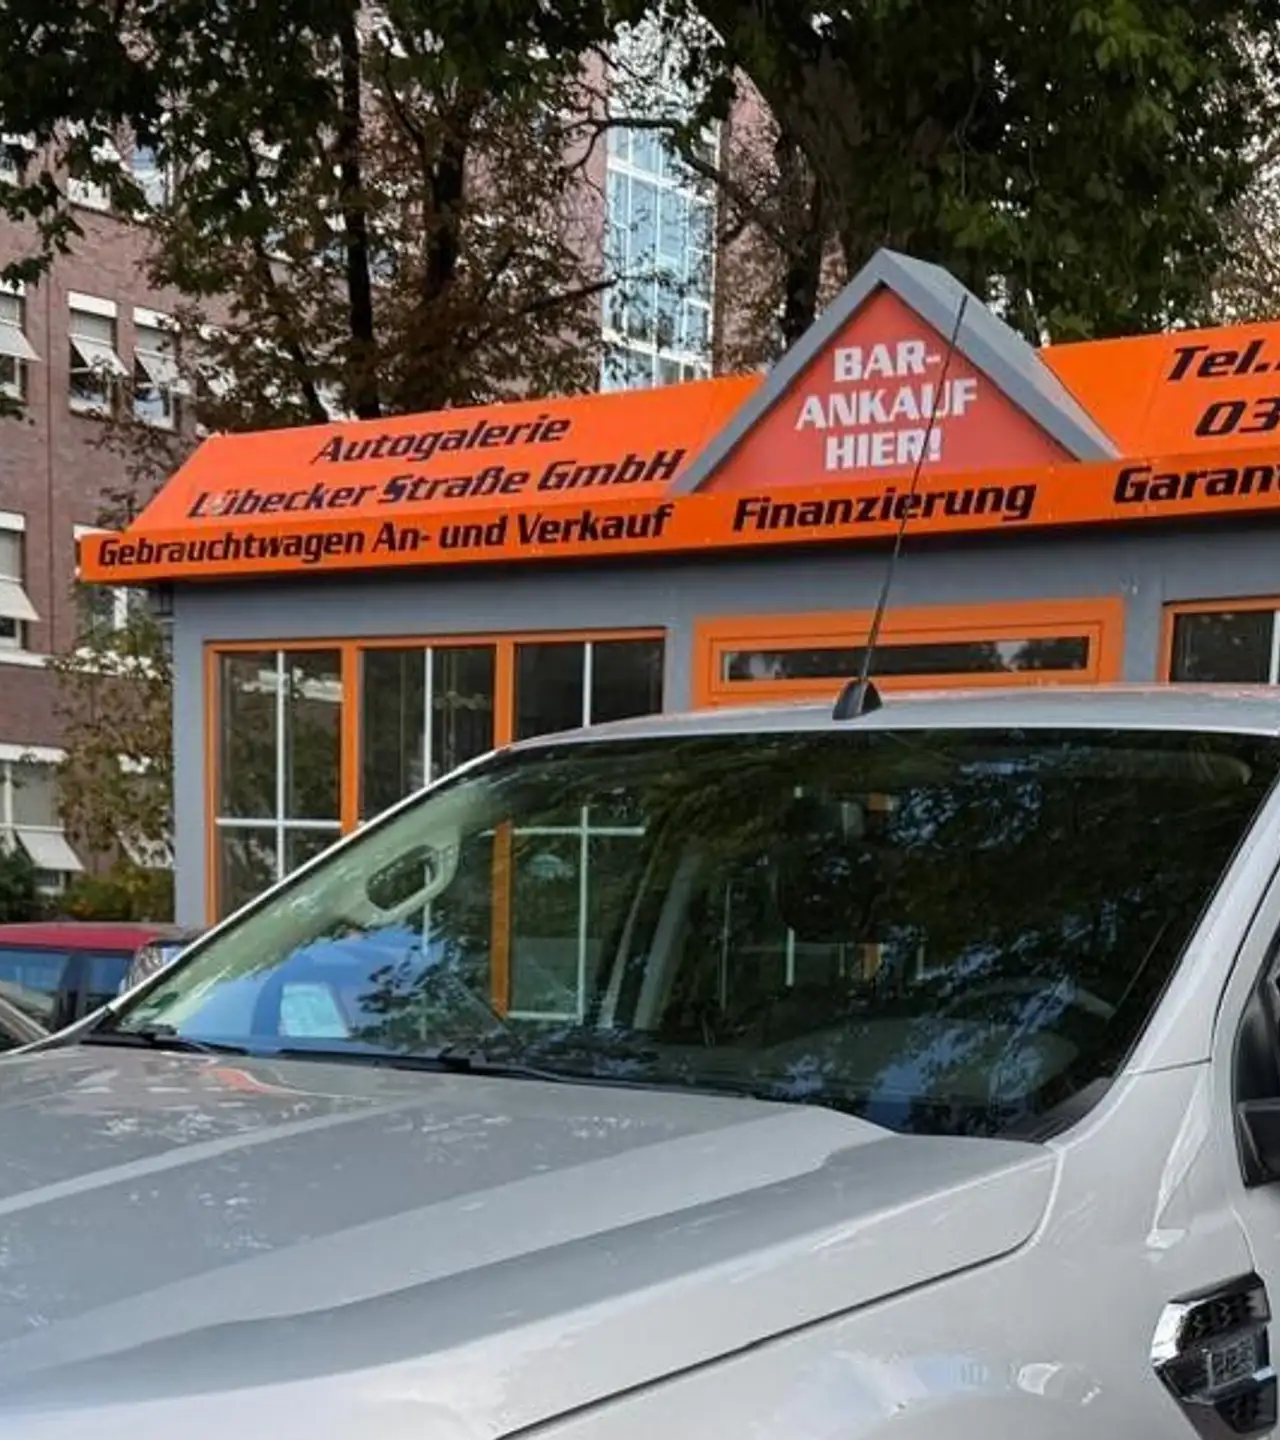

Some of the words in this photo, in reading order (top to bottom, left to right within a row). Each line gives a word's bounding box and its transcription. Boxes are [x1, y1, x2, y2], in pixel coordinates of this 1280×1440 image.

[834, 340, 941, 382] BAR-
[795, 378, 977, 431] ANKAUF
[310, 414, 571, 465] Autogalerie
[825, 428, 942, 470] HIER!
[187, 483, 376, 518] Lübecker
[377, 466, 530, 503] Straße
[537, 450, 686, 491] GmbH
[733, 485, 1037, 531] Finanzierung
[98, 531, 365, 566] Gebrauchtwagen
[372, 522, 430, 551] An-
[439, 515, 508, 549] und
[518, 504, 674, 545] Verkauf
